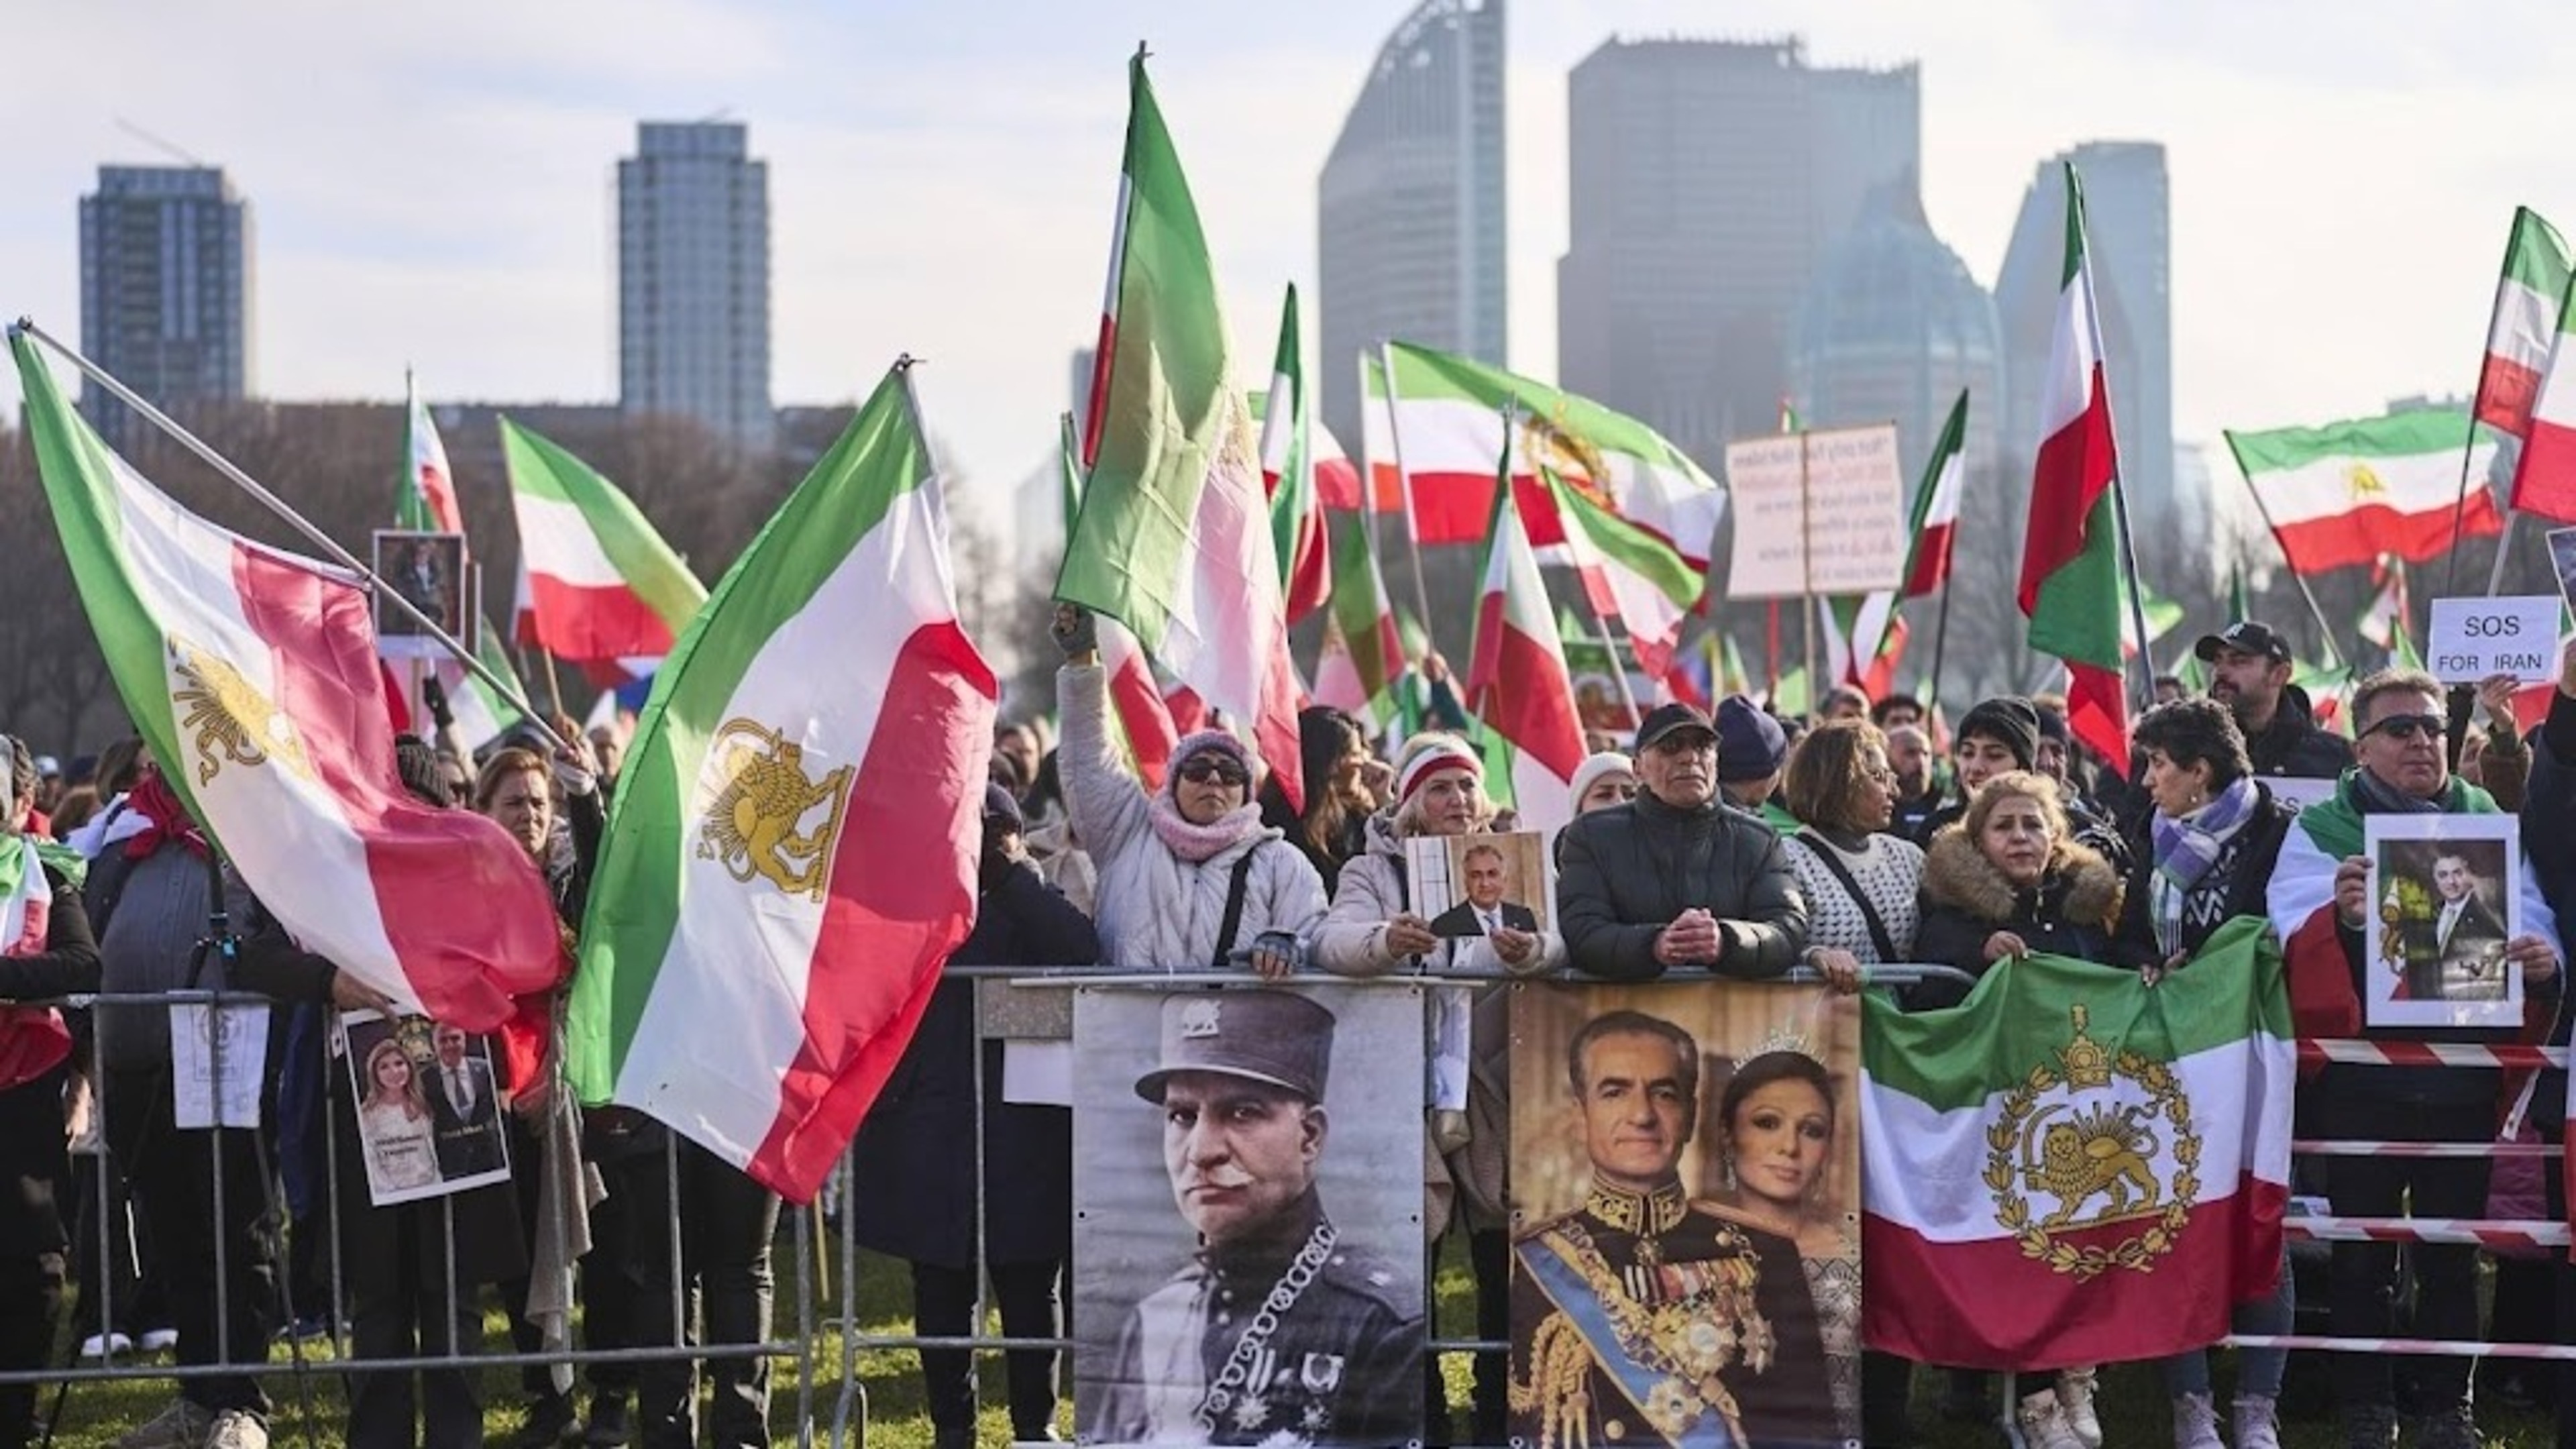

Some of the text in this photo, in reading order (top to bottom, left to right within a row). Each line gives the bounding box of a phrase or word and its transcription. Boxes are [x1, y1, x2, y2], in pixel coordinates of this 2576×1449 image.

[2464, 615, 2521, 637] SOS
[2438, 653, 2542, 672] FOR IRAN
